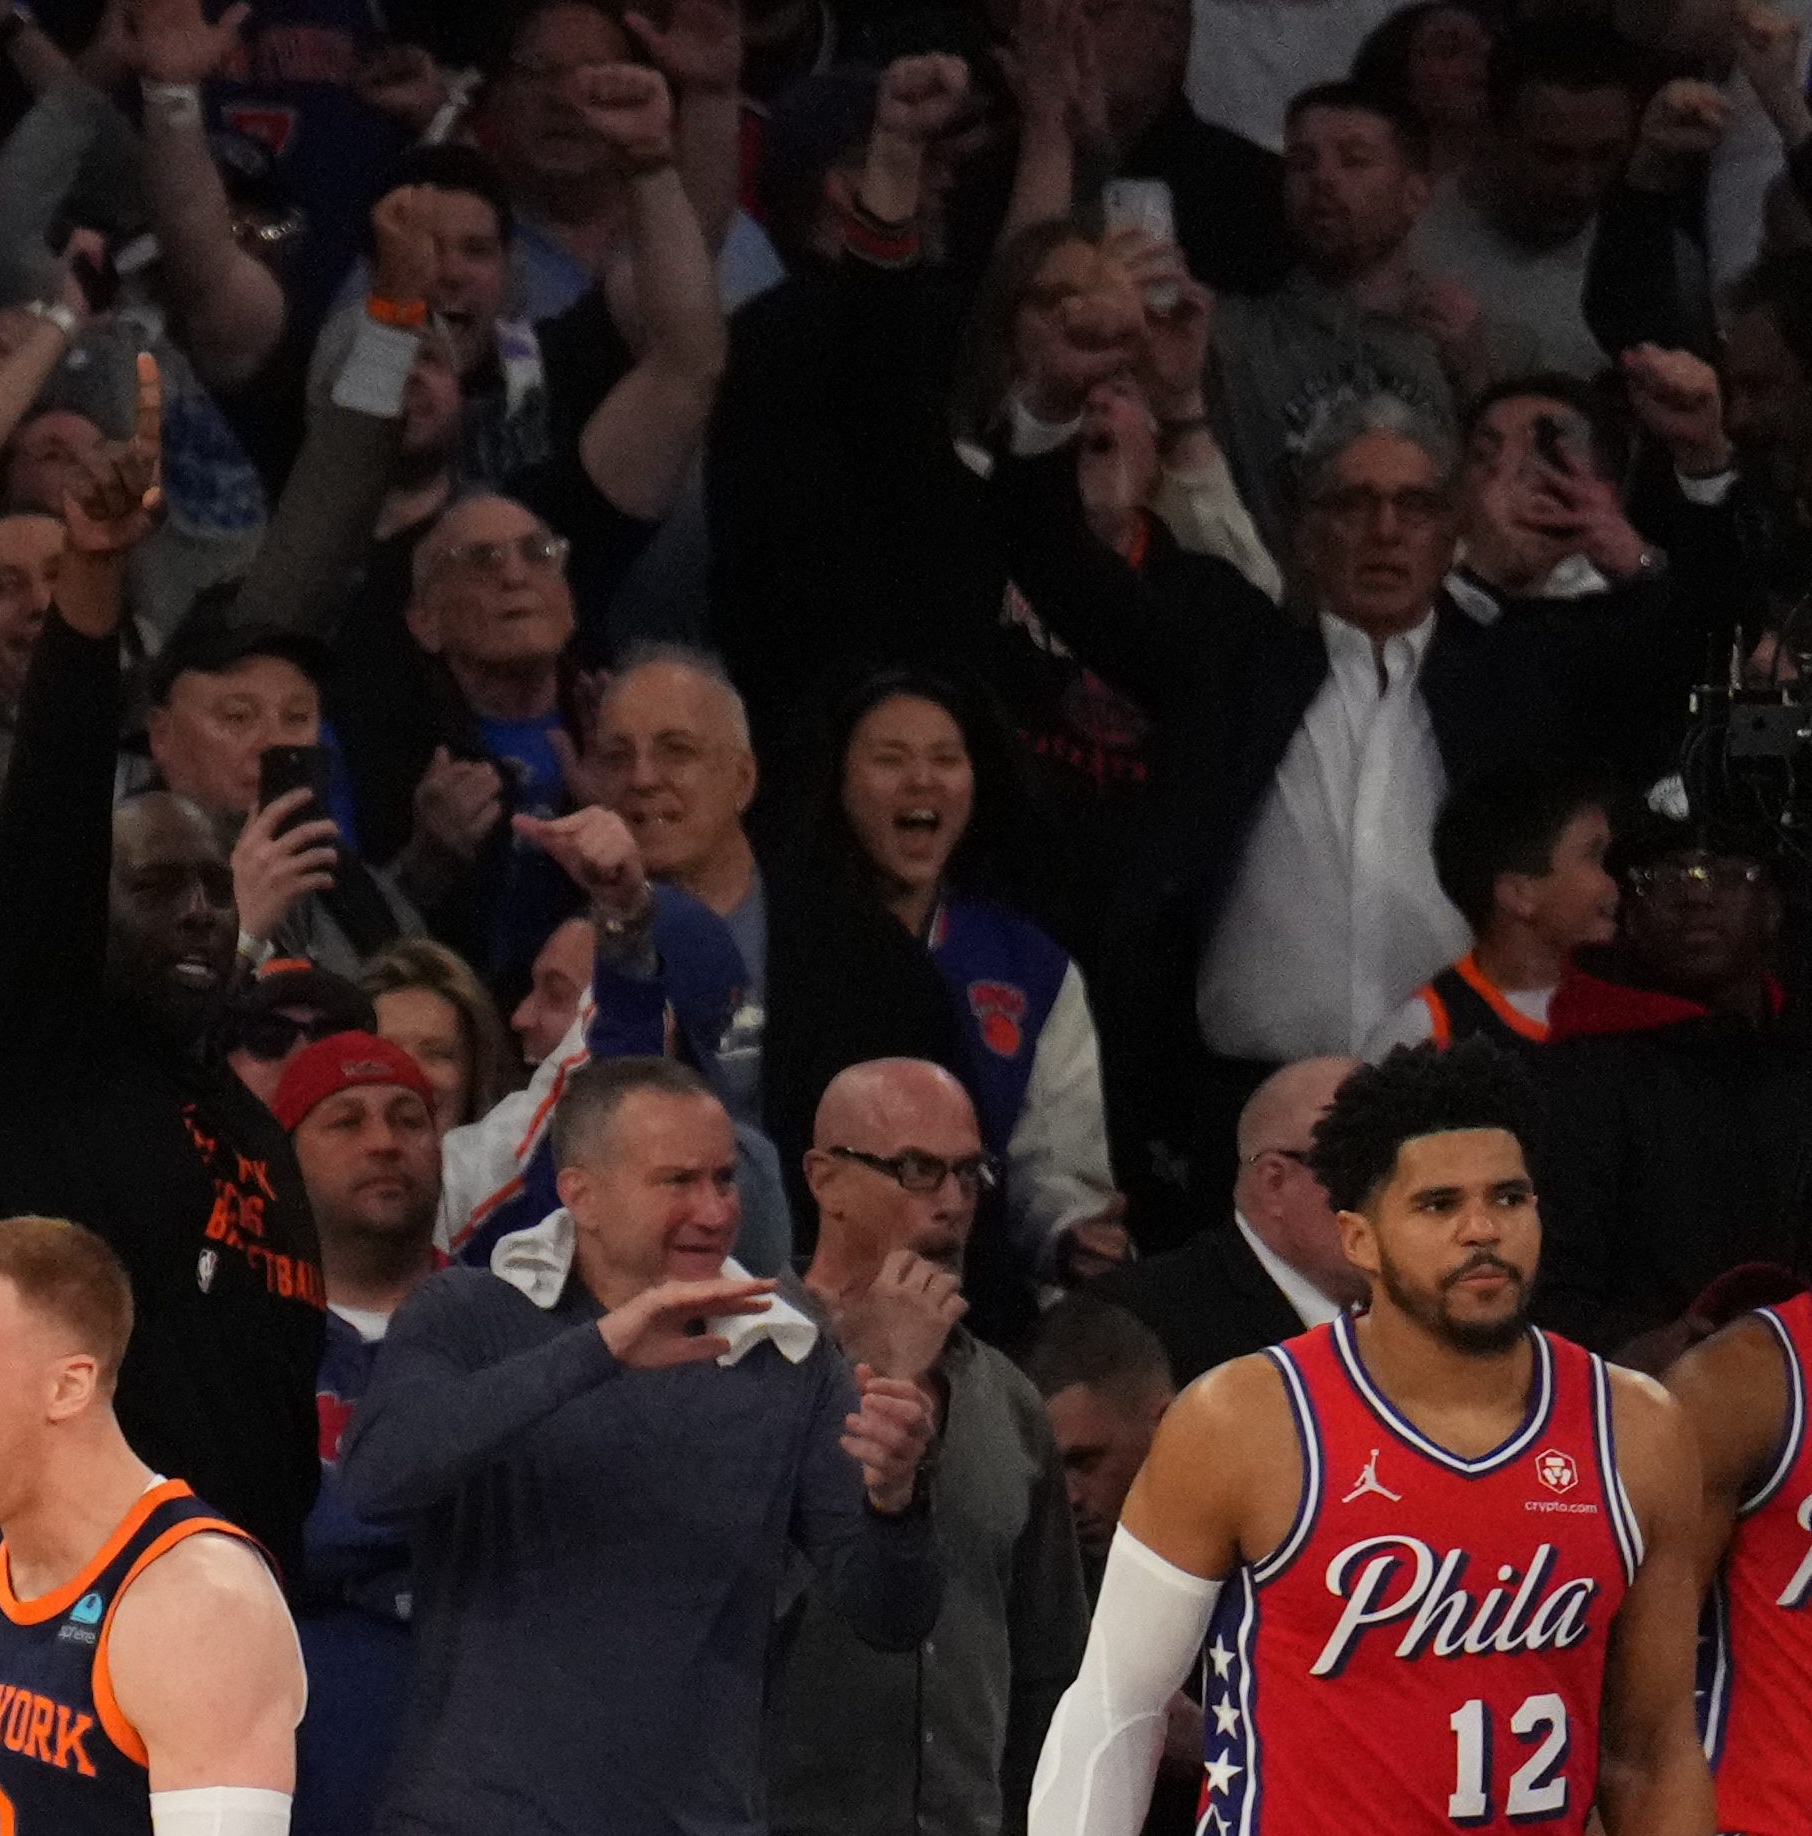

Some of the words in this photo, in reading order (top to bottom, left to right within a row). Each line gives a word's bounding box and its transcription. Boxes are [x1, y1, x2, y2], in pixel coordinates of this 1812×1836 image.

[1524, 1500, 1598, 1515] crypto.com
[1309, 1534, 1596, 1676] Phila
[1447, 1692, 1567, 1819] 12
